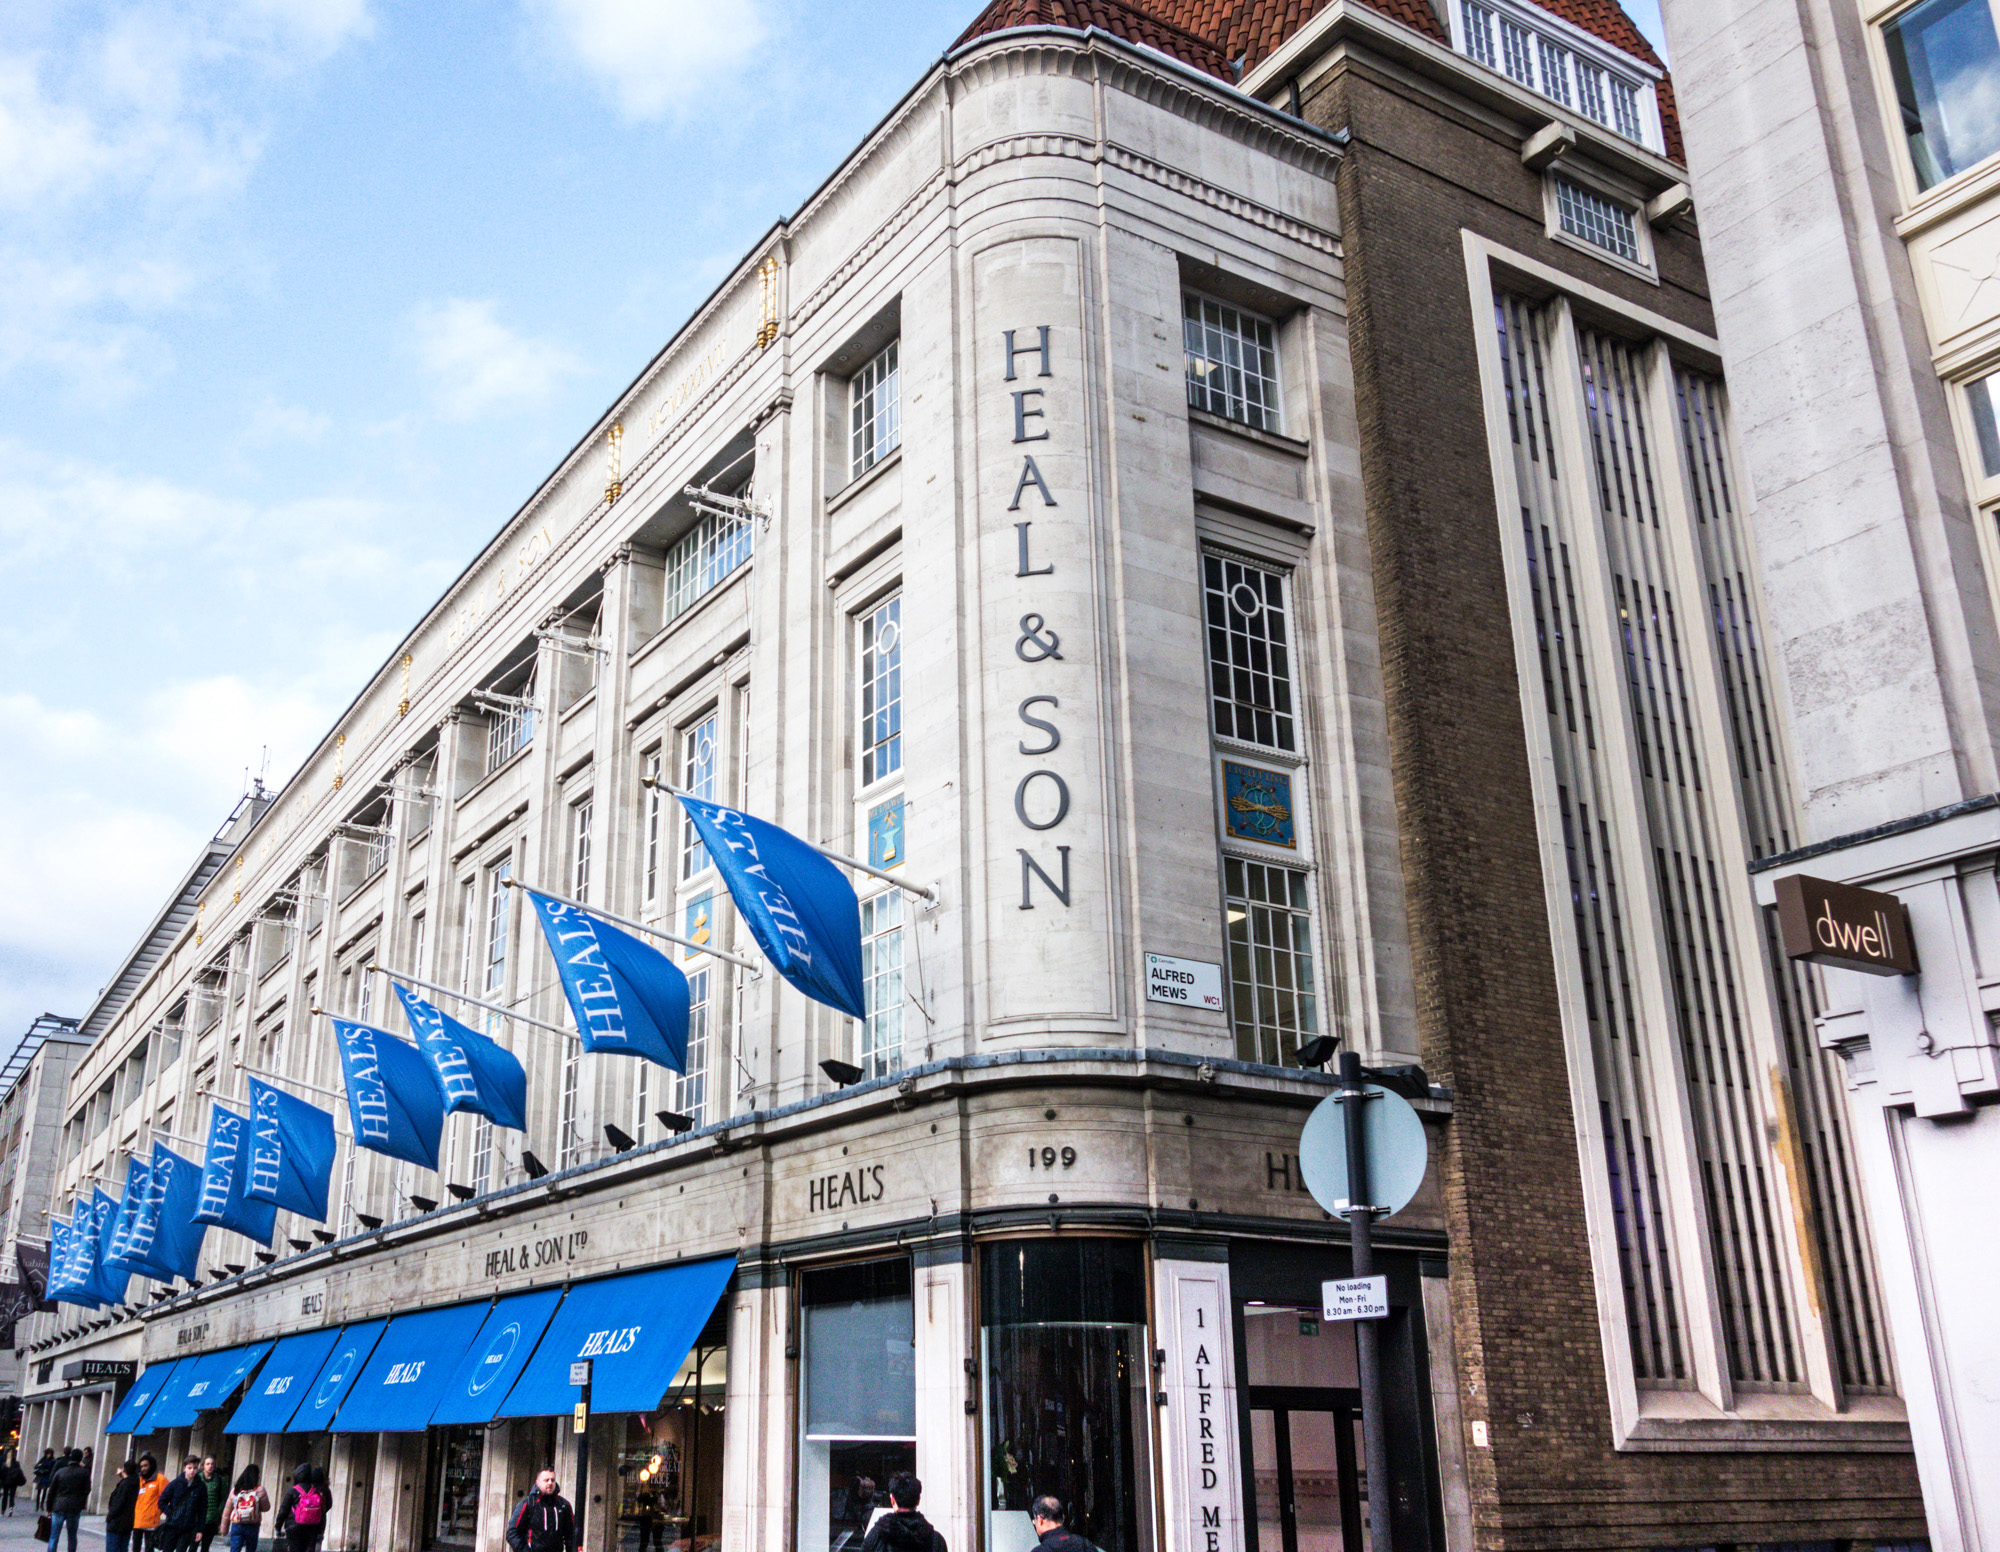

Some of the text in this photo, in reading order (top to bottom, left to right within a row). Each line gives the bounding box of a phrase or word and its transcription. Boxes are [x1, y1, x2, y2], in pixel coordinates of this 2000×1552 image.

[1002, 324, 1070, 910] HEAL & SON
[1227, 763, 1288, 786] LIGHTING
[700, 807, 812, 968] HEAL'S
[1816, 898, 1893, 959] dwell
[545, 901, 628, 1043] HEAL'S
[1151, 967, 1195, 985] ALFRED
[1152, 983, 1187, 1000] MEWS
[1203, 995, 1220, 1006] WC1
[343, 1027, 389, 1143] HEAL'S
[251, 1087, 282, 1197] HEAL'S
[198, 1115, 241, 1220] HEAL'S
[1028, 1146, 1077, 1169] 199
[809, 1164, 884, 1213] HEAL'S
[127, 1155, 174, 1258] HEAL'S
[484, 1247, 516, 1277] HEAL
[519, 1245, 530, 1270] &
[534, 1236, 564, 1267] SON
[1336, 1282, 1371, 1292] No loading
[1339, 1296, 1353, 1304] Mon
[1357, 1294, 1366, 1302] Fri
[301, 1292, 324, 1315] HEAL'S
[1326, 1307, 1342, 1316] 8.30
[1357, 1305, 1373, 1314] 6.30
[1374, 1305, 1385, 1313] pm
[1196, 1307, 1205, 1328] 1
[577, 1326, 641, 1357] HEAL'S
[85, 1362, 131, 1375] HEAL'S
[383, 1361, 425, 1385] HEAL'S
[264, 1376, 294, 1395] HEAL'S
[575, 1405, 586, 1431] H
[1195, 1344, 1217, 1489] ALFRED
